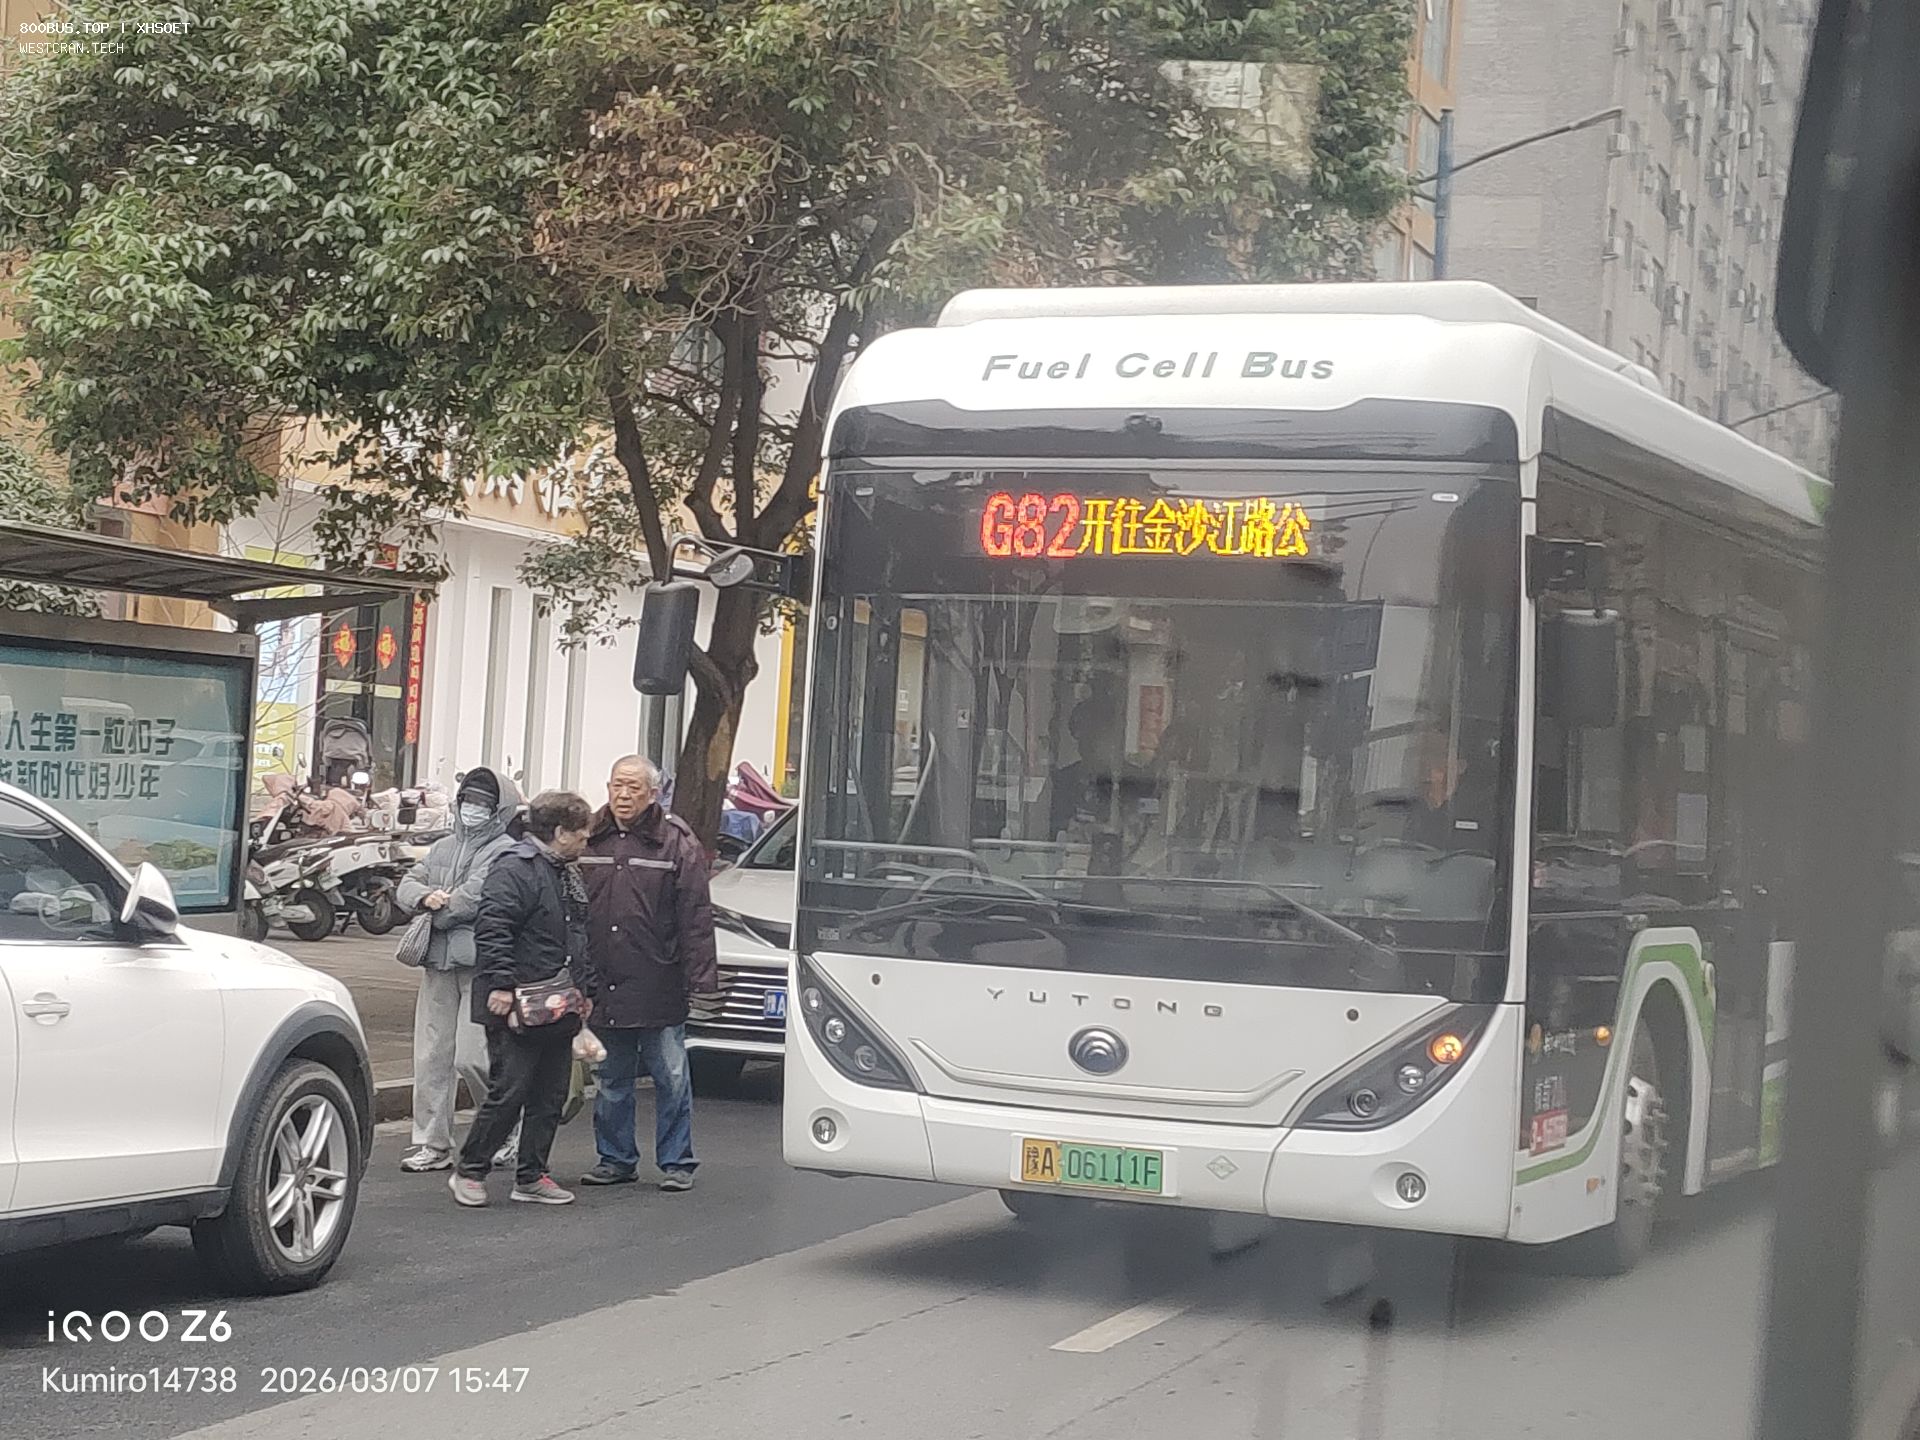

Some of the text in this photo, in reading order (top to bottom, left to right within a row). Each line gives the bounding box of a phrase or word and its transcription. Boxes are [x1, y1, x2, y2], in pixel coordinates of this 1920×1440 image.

[982, 352, 1334, 381] Fuel Cell Bus
[981, 493, 1311, 558] G82 开往金沙江路公
[986, 987, 1223, 1017] YUTONG
[1068, 1149, 1160, 1187] 06111F
